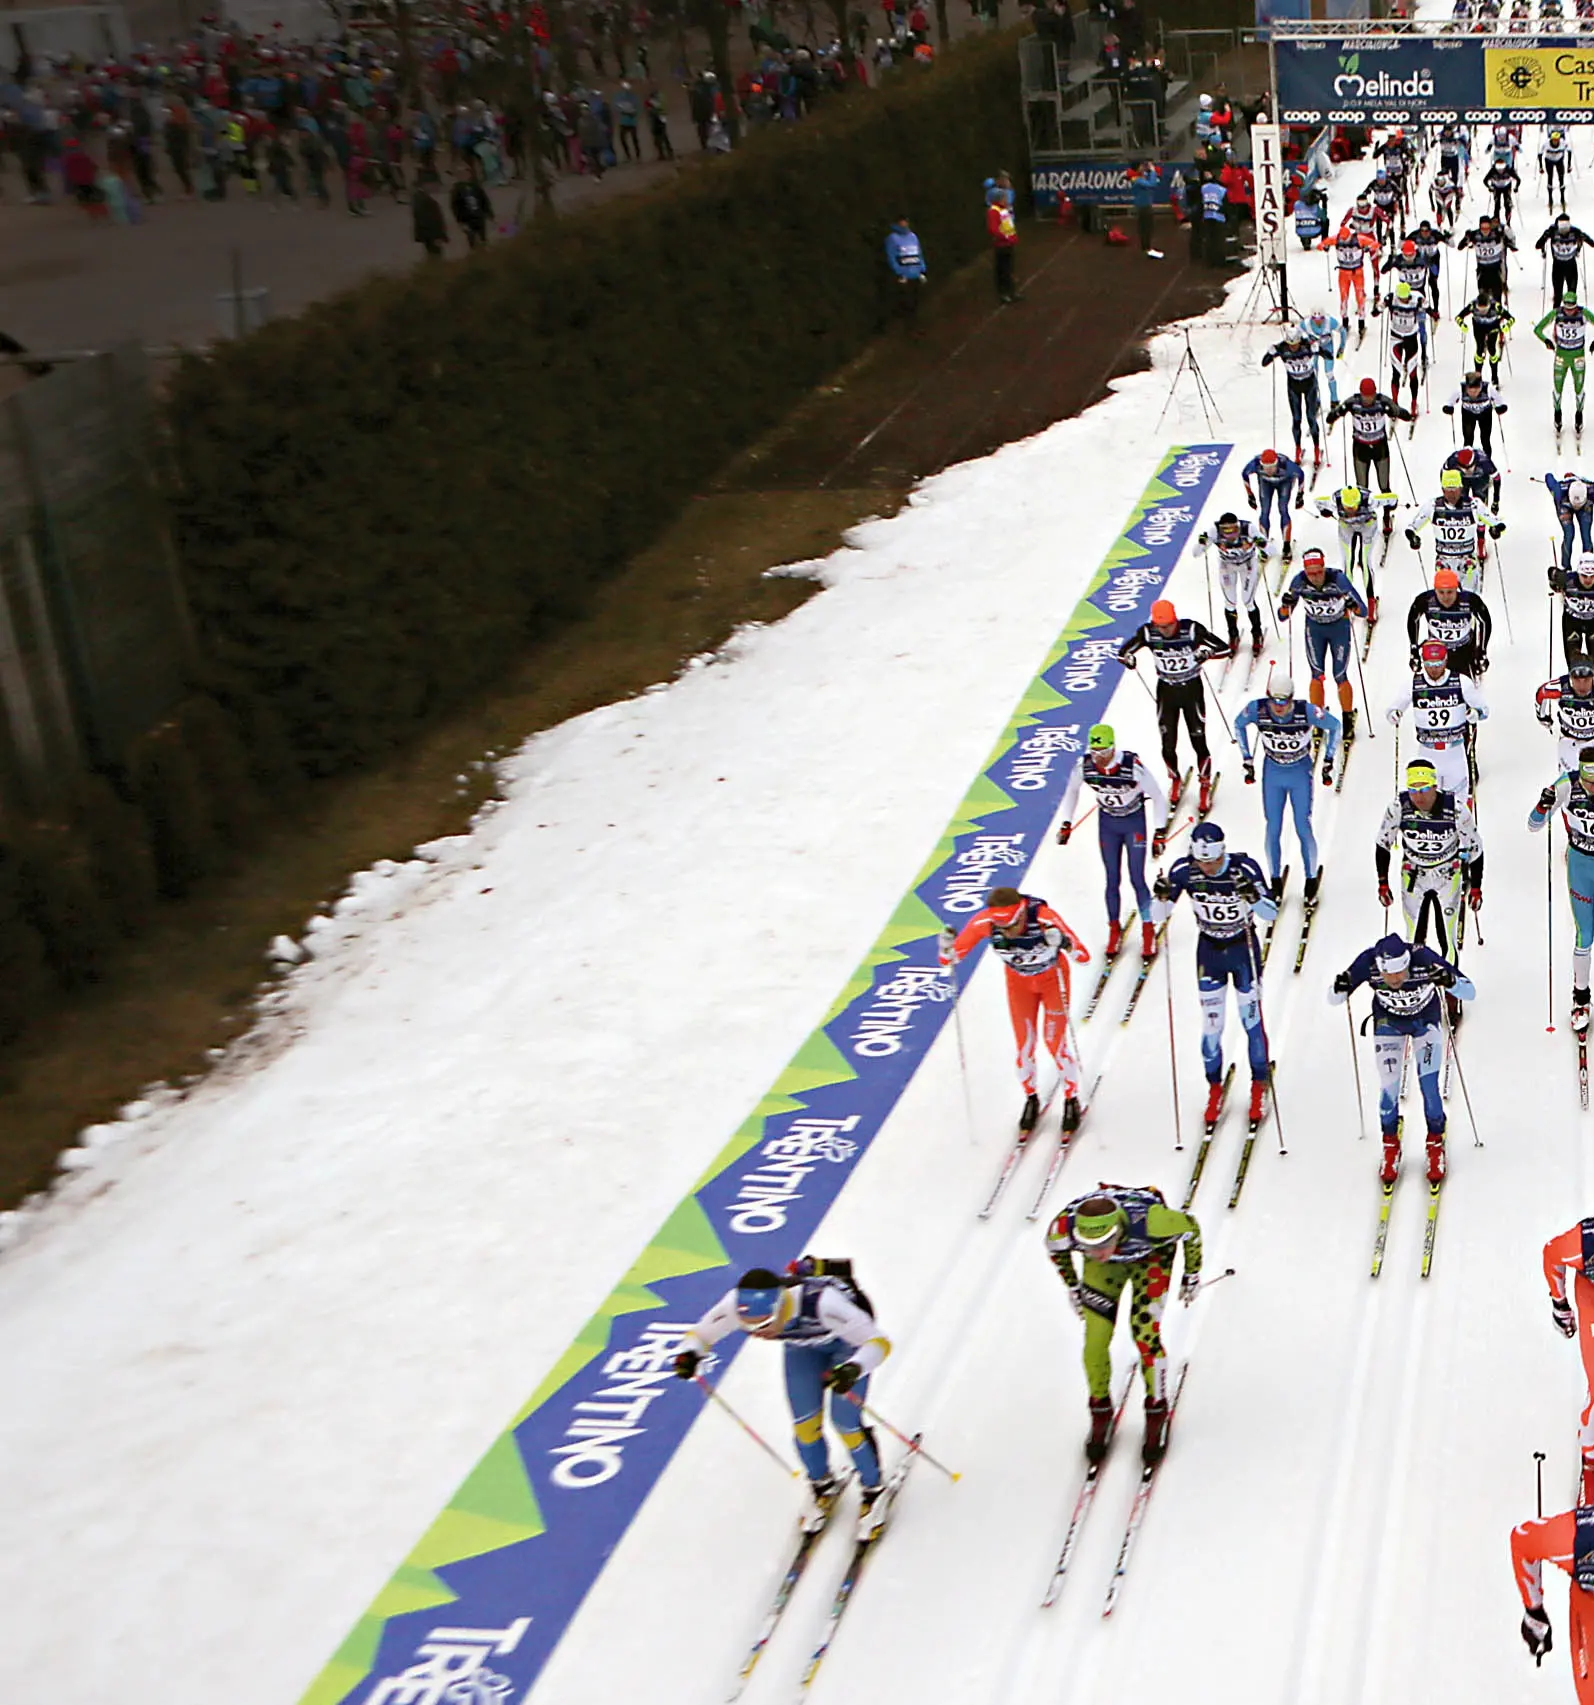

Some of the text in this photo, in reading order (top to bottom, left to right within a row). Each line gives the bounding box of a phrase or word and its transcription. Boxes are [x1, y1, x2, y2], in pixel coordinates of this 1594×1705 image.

[1334, 70, 1434, 97] Melinda
[1284, 111, 1321, 123] coop
[1328, 111, 1365, 123] coop
[1373, 111, 1410, 123] coop
[1420, 111, 1457, 123] coop
[1465, 111, 1502, 123] coop
[1509, 111, 1546, 123] coop
[1556, 111, 1593, 123] coop
[1260, 139, 1280, 235] ITAS
[1561, 328, 1578, 338] 155
[1360, 421, 1377, 431] 131
[1176, 451, 1219, 487] TRENTINO
[1142, 505, 1190, 545] TRENTINO
[1440, 527, 1466, 540] 102
[1105, 566, 1160, 612] TRENTINO
[1310, 605, 1335, 615] 126
[1437, 629, 1461, 640] 121
[1065, 637, 1123, 692] TRENTINO
[1160, 657, 1188, 671] 122
[1417, 694, 1459, 709] Melinda
[1428, 709, 1450, 728] 39
[1270, 738, 1300, 751] 160
[1011, 724, 1080, 791] TRENTINO
[1104, 794, 1123, 807] 61
[1417, 841, 1443, 851] 23
[939, 833, 1025, 913] TRENTINO
[1200, 905, 1240, 920] 165
[849, 965, 950, 1058] TRENTINO
[724, 1115, 862, 1234] TRENTINO
